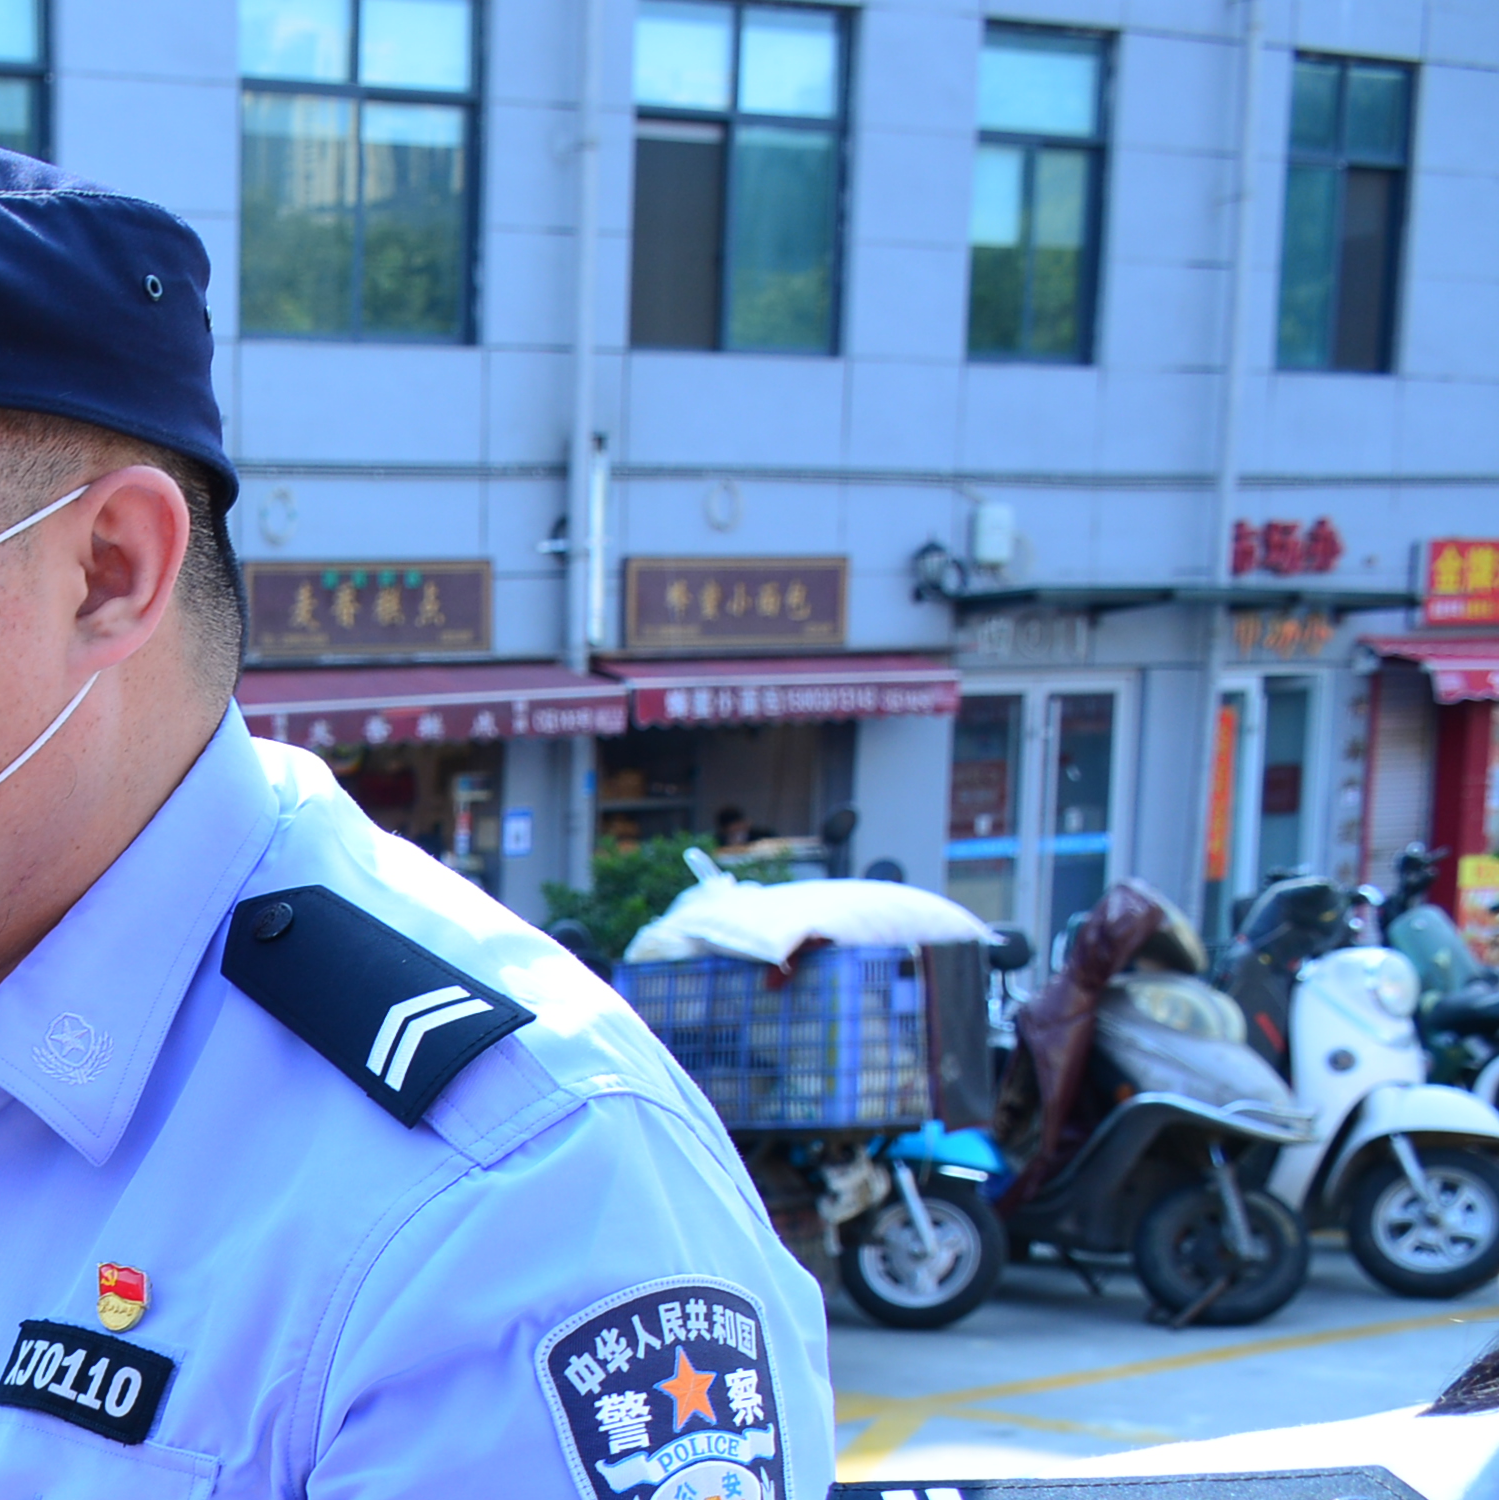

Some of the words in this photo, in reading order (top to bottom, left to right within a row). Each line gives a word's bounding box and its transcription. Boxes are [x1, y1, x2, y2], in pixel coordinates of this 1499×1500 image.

[4, 1339, 142, 1418] XJ0110
[563, 1298, 758, 1397] 中华人民共和国
[658, 1434, 740, 1474] POLICE
